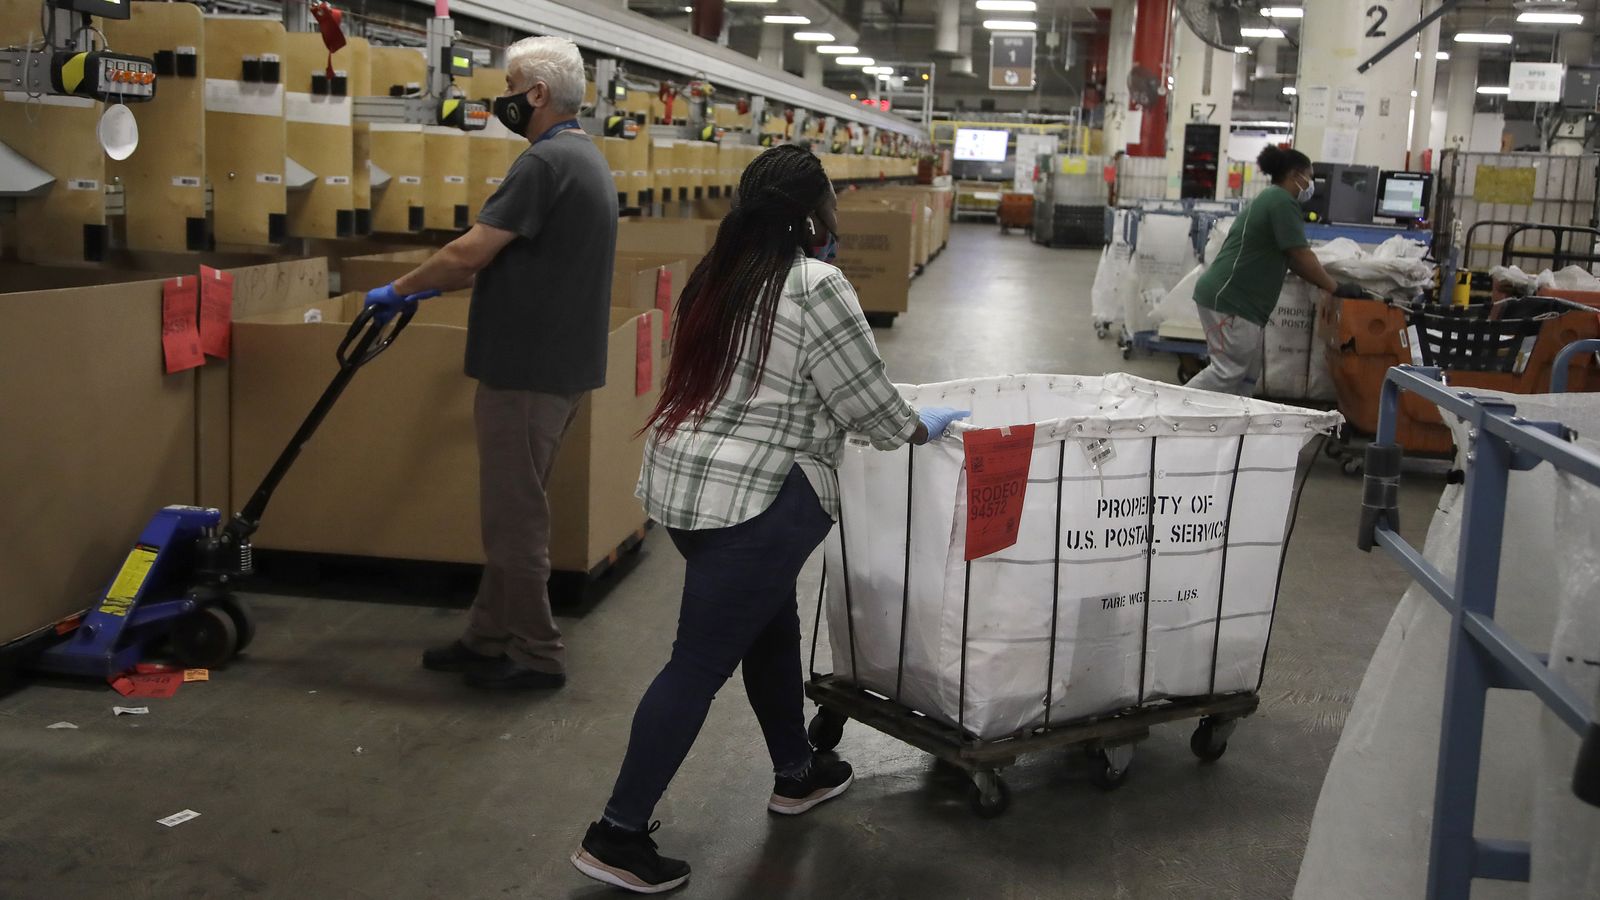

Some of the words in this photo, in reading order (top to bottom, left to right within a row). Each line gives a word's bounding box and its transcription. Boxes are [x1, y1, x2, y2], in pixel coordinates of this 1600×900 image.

[1365, 4, 1388, 38] 2
[1008, 49, 1016, 63] 1
[1567, 125, 1575, 135] 2
[1281, 319, 1314, 329] POSTA
[971, 481, 1019, 505] RODEO
[970, 501, 1008, 521] 94572
[1097, 495, 1182, 519] PROPERTY
[1191, 495, 1213, 514] OF
[1067, 530, 1097, 550] U.S.
[1105, 525, 1161, 548] POSTAL
[1101, 596, 1126, 610] TARE
[1177, 588, 1199, 602] LBS.
